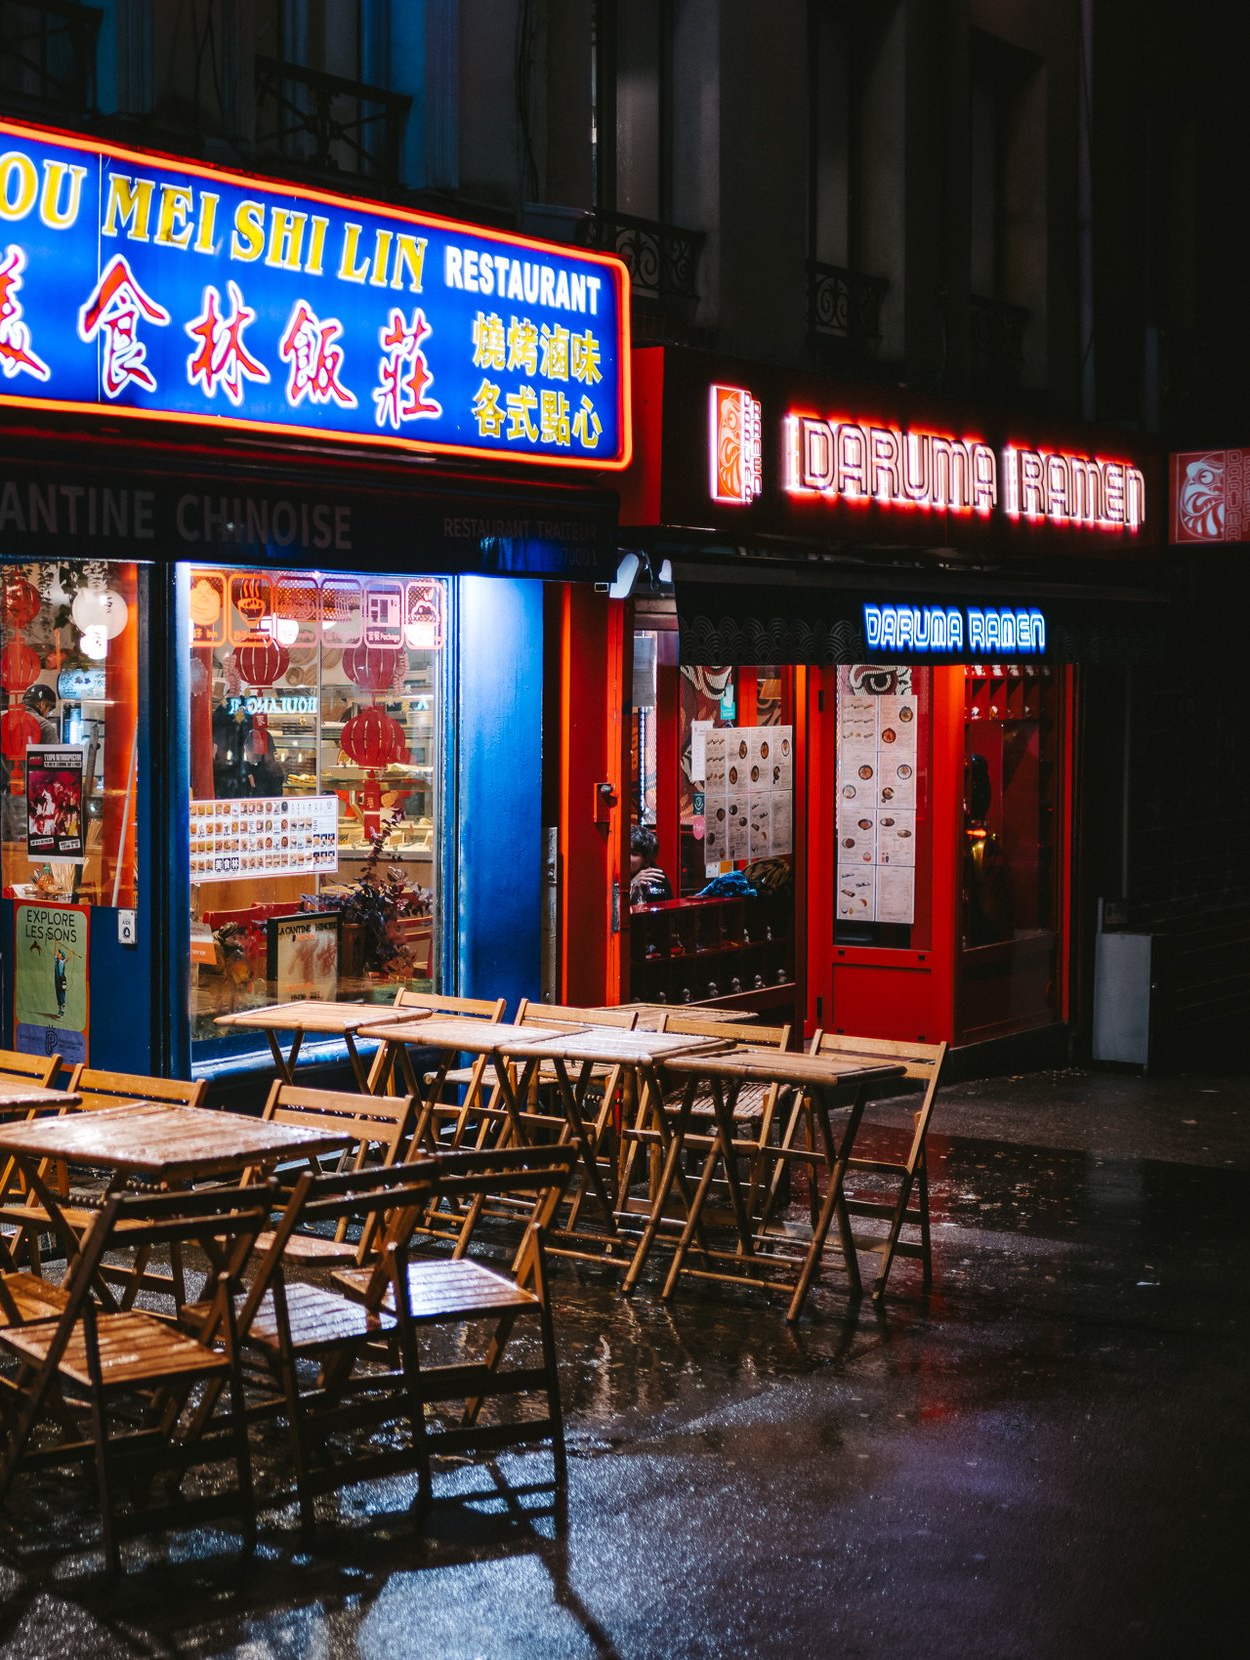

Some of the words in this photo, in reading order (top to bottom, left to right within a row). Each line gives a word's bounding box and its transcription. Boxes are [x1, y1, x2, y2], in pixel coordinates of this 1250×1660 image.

[101, 172, 220, 253] MEI
[231, 199, 330, 276] SHI
[337, 224, 428, 293] LIN
[445, 245, 601, 315] RESTAURANT
[471, 378, 603, 448] 各式點心
[786, 413, 998, 509] DARUMA
[1006, 446, 1146, 526] RAMEN
[175, 493, 353, 551] CHINOISE
[864, 604, 962, 649] DARUMA
[968, 607, 1046, 652] RAMEN
[25, 925, 44, 939] LES
[47, 927, 77, 943] SONS
[26, 909, 75, 927] EXPLORE
